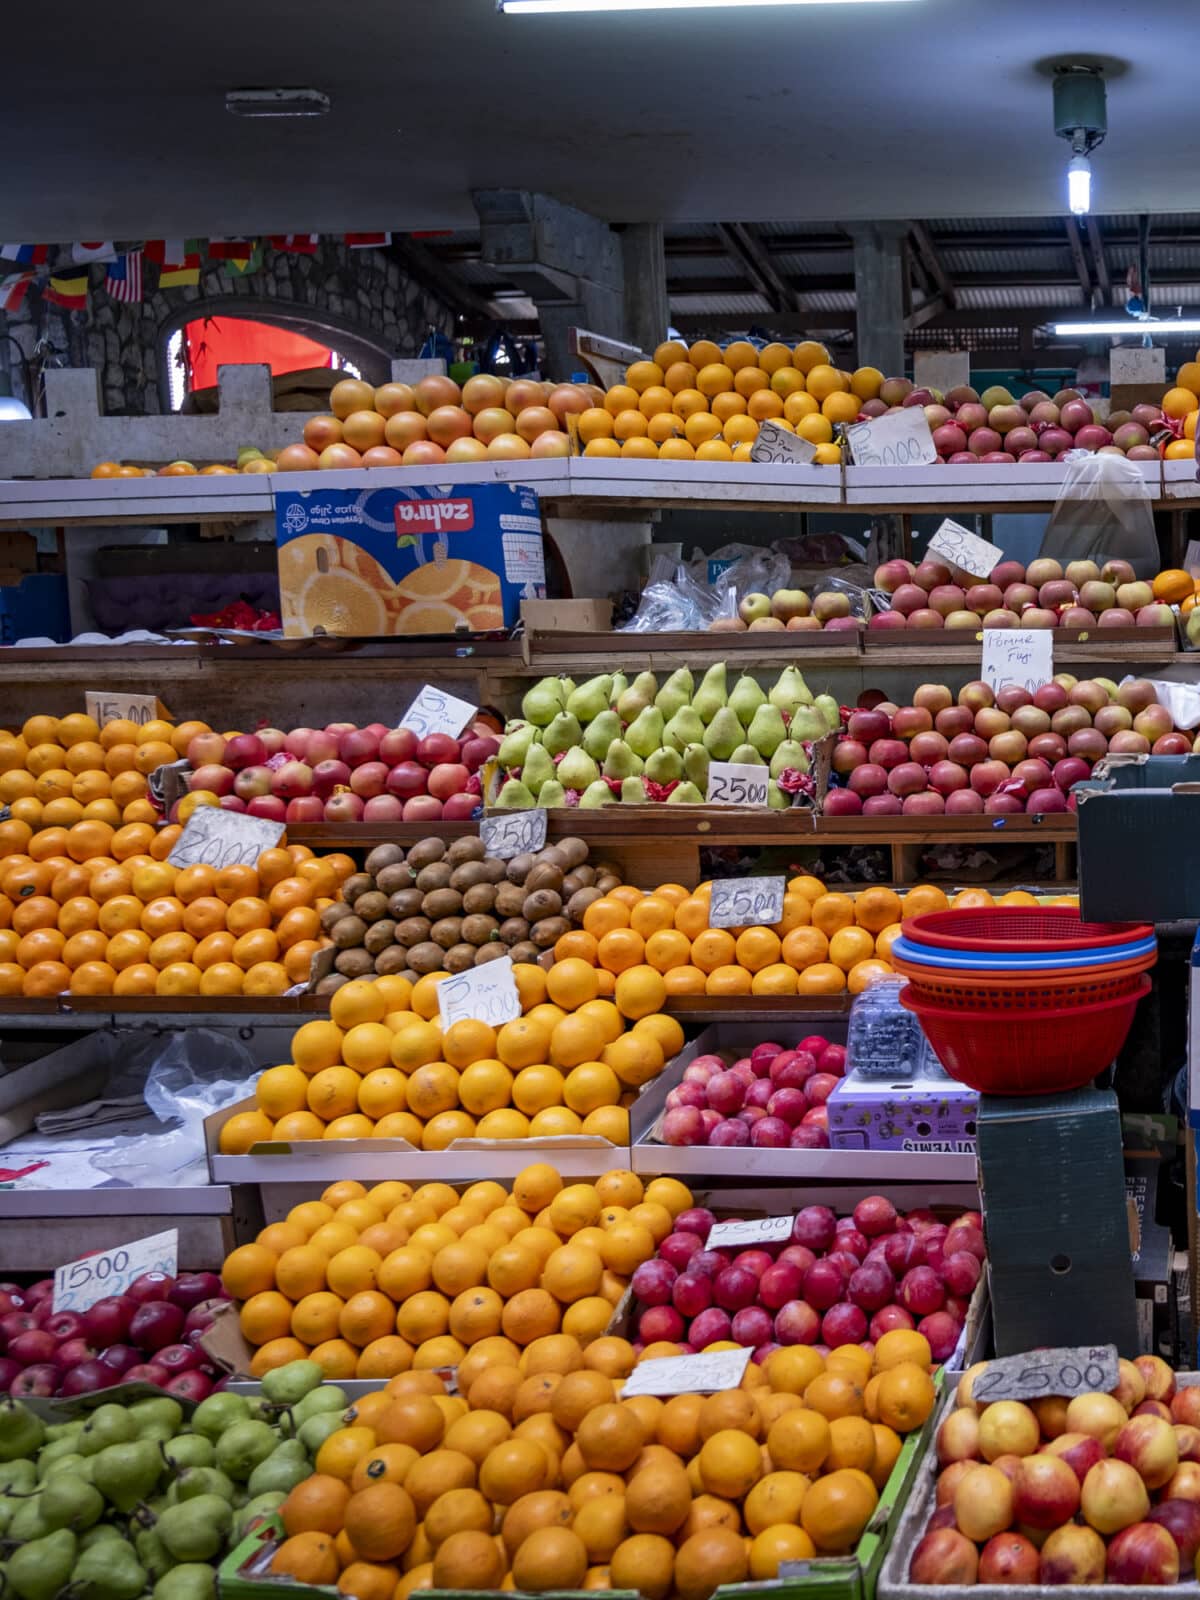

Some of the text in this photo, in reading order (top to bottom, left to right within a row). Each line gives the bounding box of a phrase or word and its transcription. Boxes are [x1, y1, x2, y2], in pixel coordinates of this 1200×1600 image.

[400, 502, 470, 530] zahra
[60, 1250, 130, 1292] 15.00
[974, 1364, 1104, 1400] 25.00
